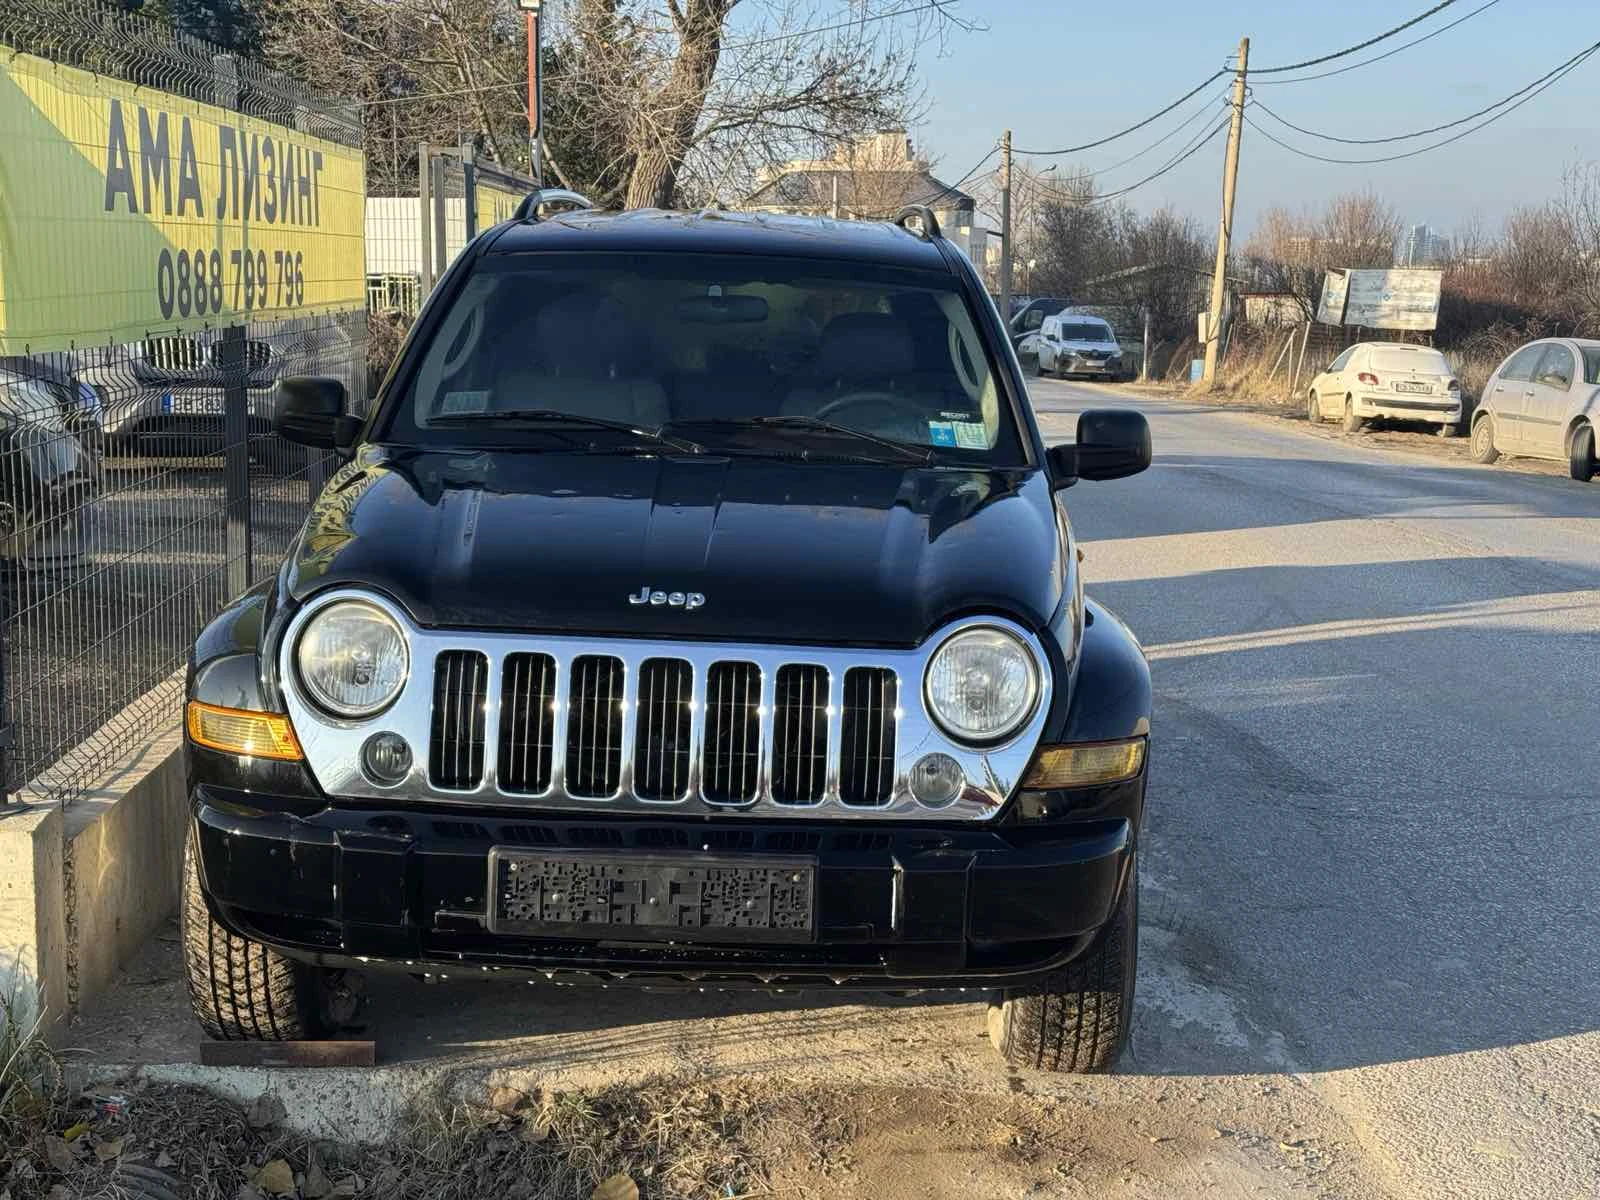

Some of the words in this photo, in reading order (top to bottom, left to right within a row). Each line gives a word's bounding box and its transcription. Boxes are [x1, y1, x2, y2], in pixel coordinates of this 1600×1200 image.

[104, 98, 204, 217] АМА
[217, 124, 323, 227] ЛИЗИНГ
[157, 248, 223, 320] 0888
[231, 249, 268, 311] 799
[274, 250, 304, 306] 796
[628, 586, 706, 609] Jeep
